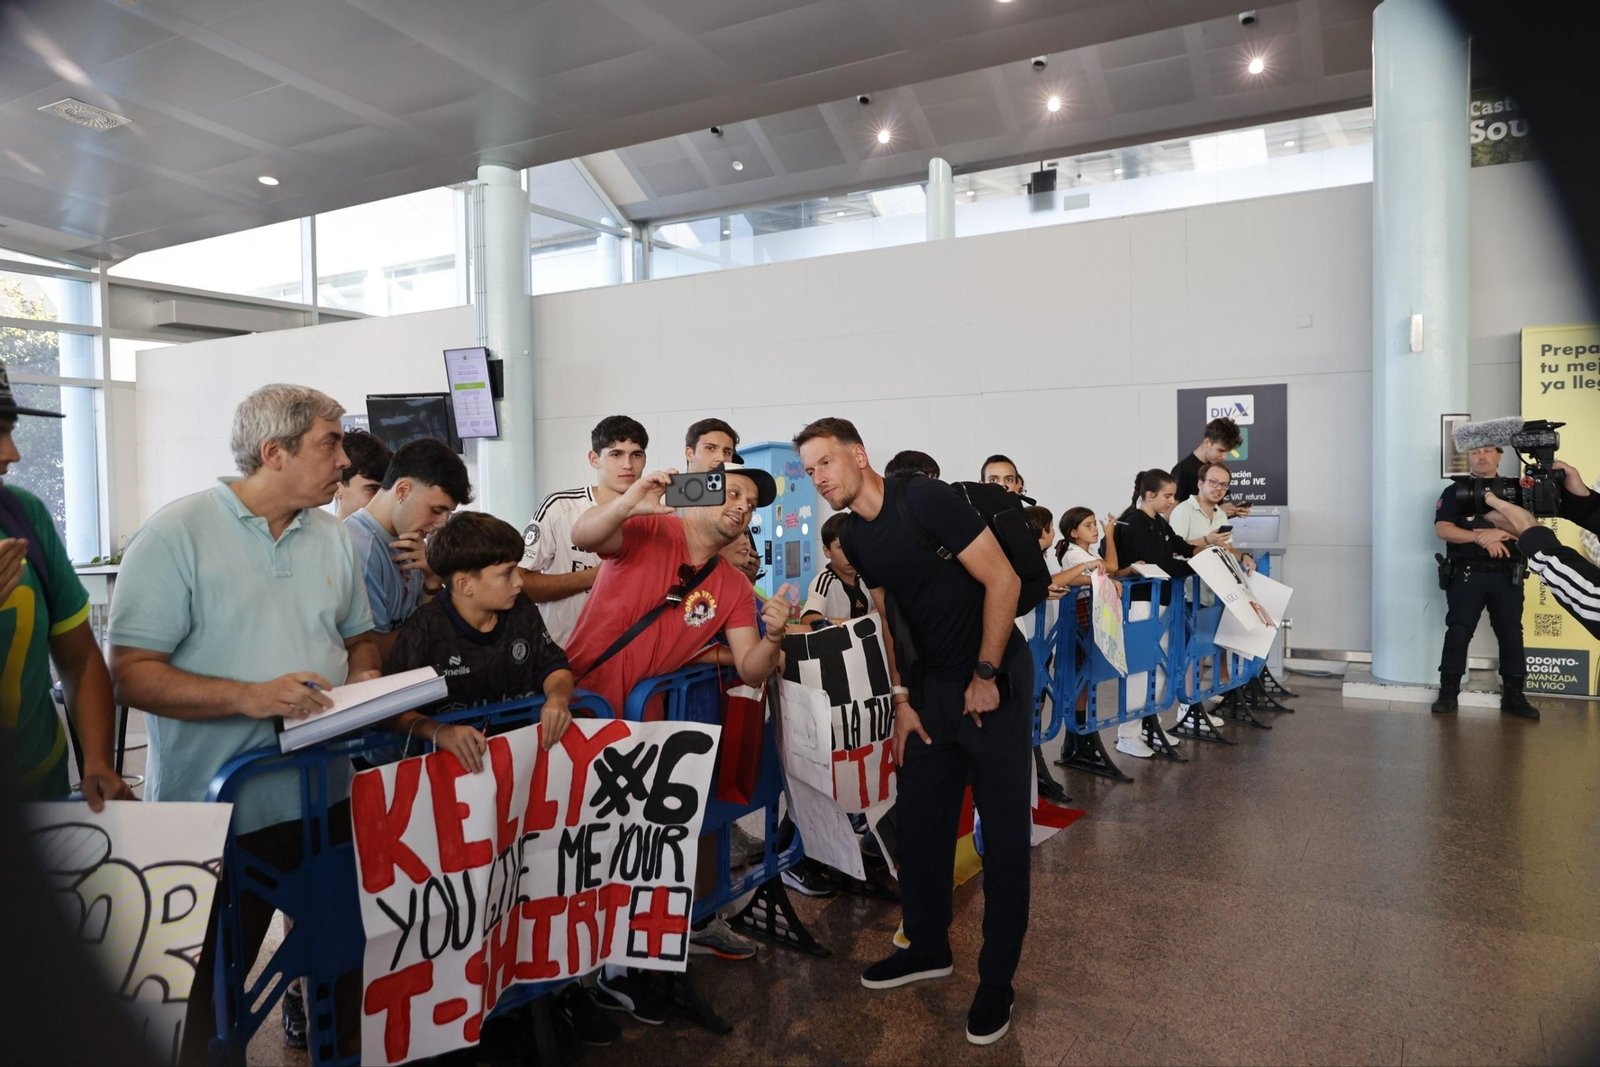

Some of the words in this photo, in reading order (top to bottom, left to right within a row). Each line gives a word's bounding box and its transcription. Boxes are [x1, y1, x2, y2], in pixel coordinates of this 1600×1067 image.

[1470, 97, 1519, 116] Cast
[1541, 344, 1600, 359] Prepa
[1540, 362, 1559, 373] tu
[1540, 380, 1565, 394] ya
[1230, 470, 1251, 478] ución
[1240, 478, 1250, 486] do
[1526, 673, 1578, 683] AVANZADA
[1526, 681, 1539, 689] EN
[1541, 682, 1566, 690] VIGO
[841, 699, 861, 751] LA
[352, 719, 631, 893] KELLY
[376, 869, 478, 971] YOU
[557, 822, 610, 897] ME
[609, 822, 689, 882] YOUR
[364, 882, 631, 1064] T-SHIRT
